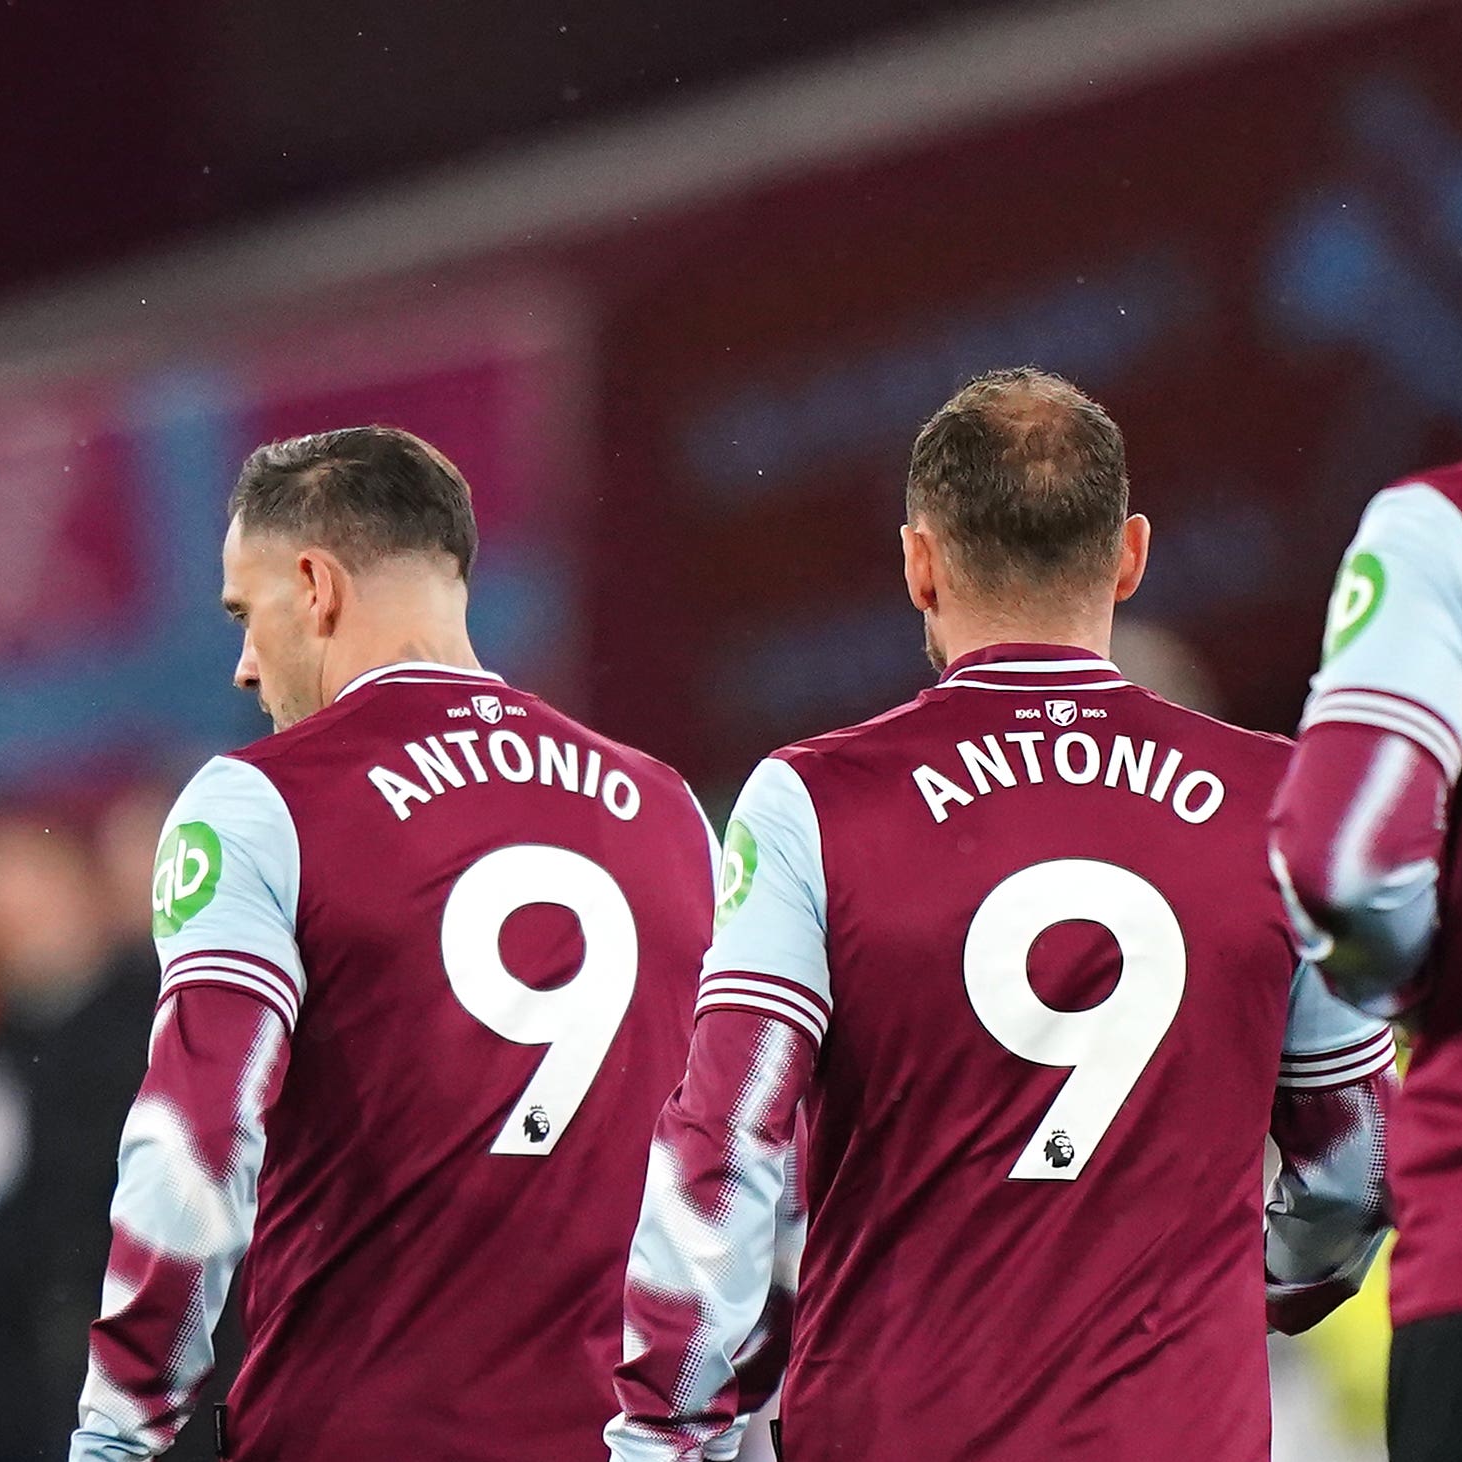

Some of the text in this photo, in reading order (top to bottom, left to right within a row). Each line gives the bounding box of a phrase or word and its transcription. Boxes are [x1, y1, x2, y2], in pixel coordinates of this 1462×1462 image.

[1015, 709, 1041, 719] 1964
[367, 729, 641, 821] ANTONIO
[912, 731, 1225, 824] ANTONIO
[440, 844, 639, 1156] 9
[963, 858, 1187, 1181] 9
